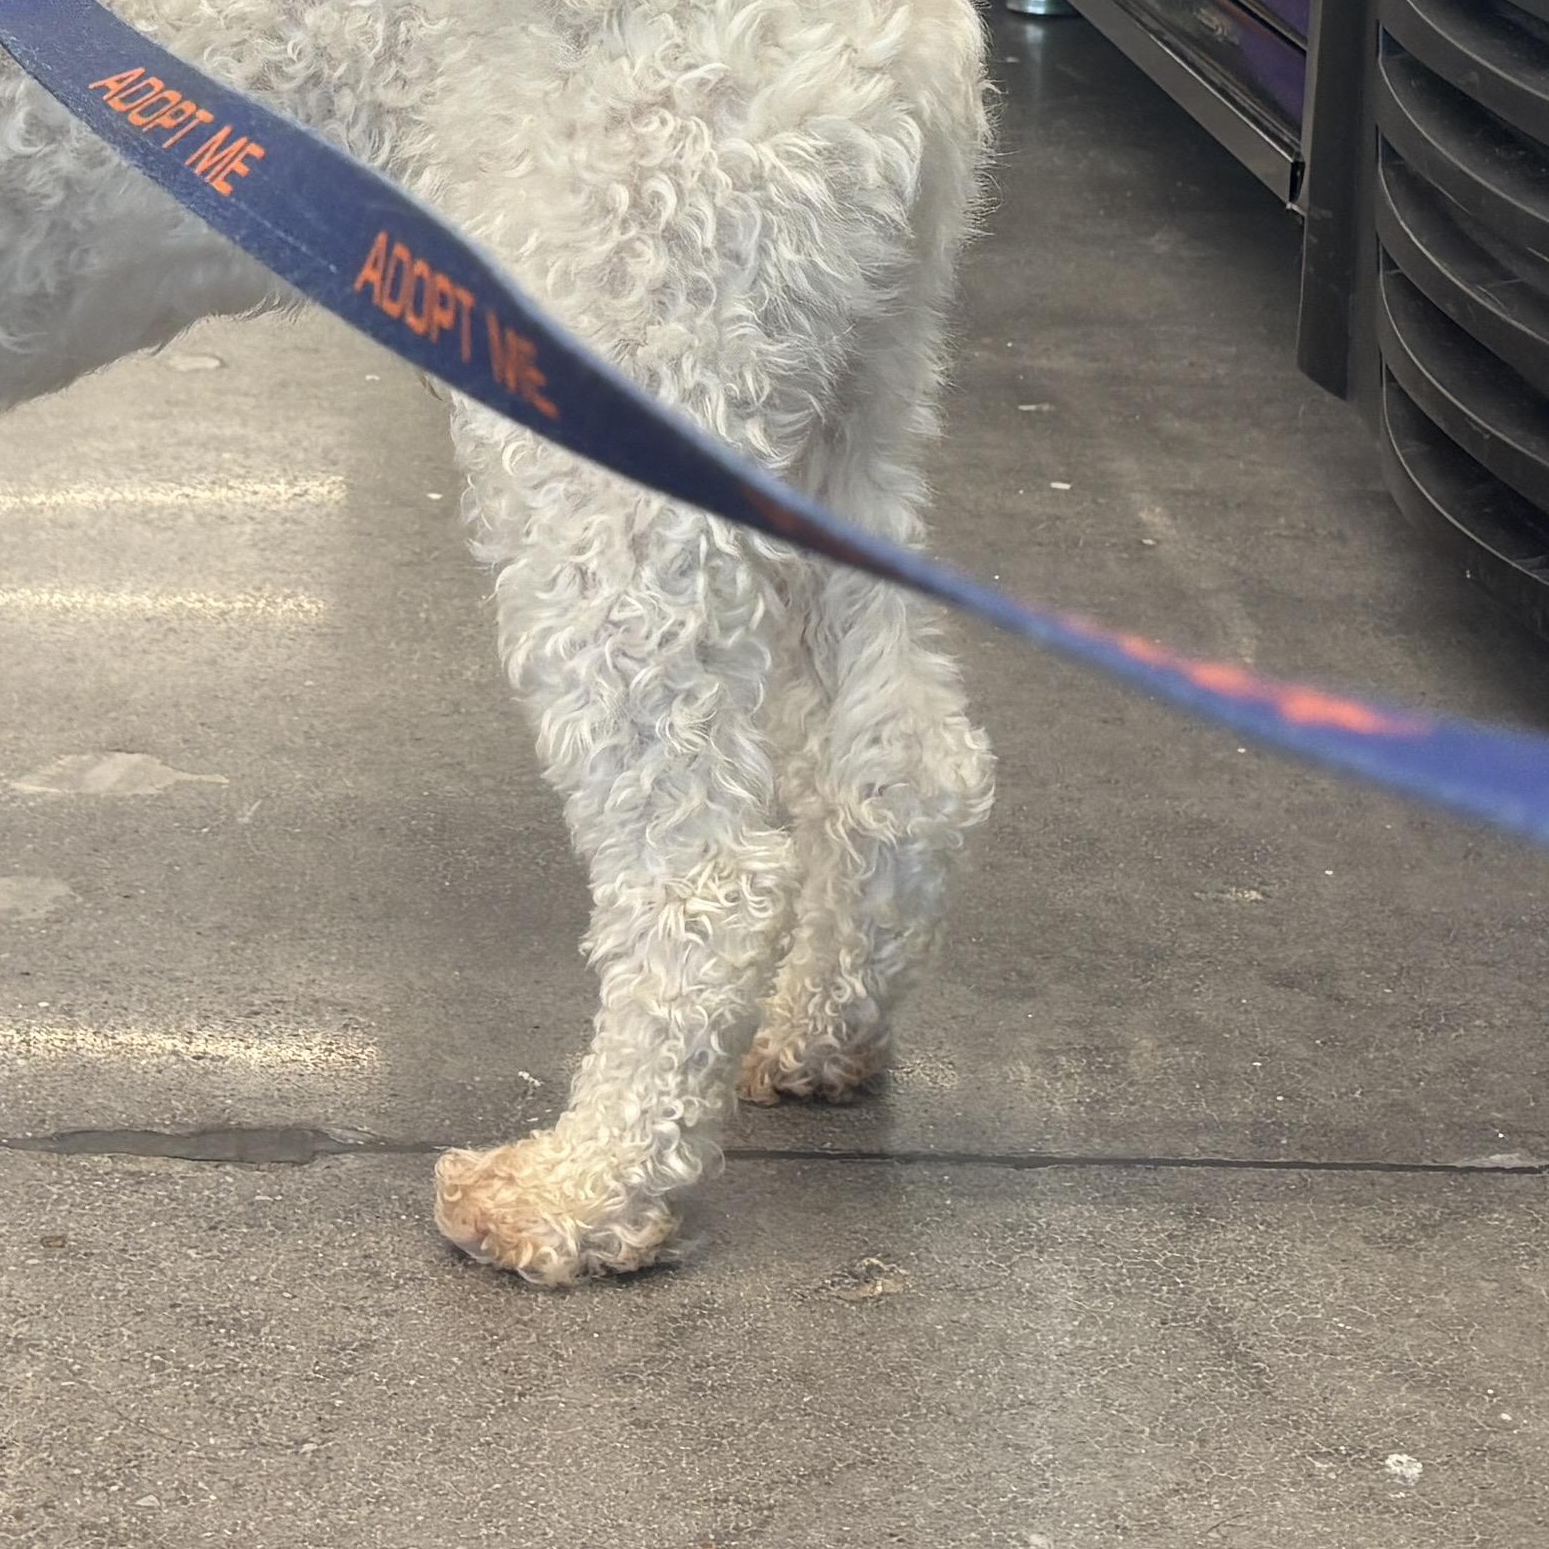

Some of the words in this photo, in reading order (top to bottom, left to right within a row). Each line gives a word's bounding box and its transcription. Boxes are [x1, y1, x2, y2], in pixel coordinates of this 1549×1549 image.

[88, 66, 215, 150] ADOPT
[184, 124, 266, 197] ME
[354, 229, 477, 364] ADOPT
[485, 308, 560, 420] ME
